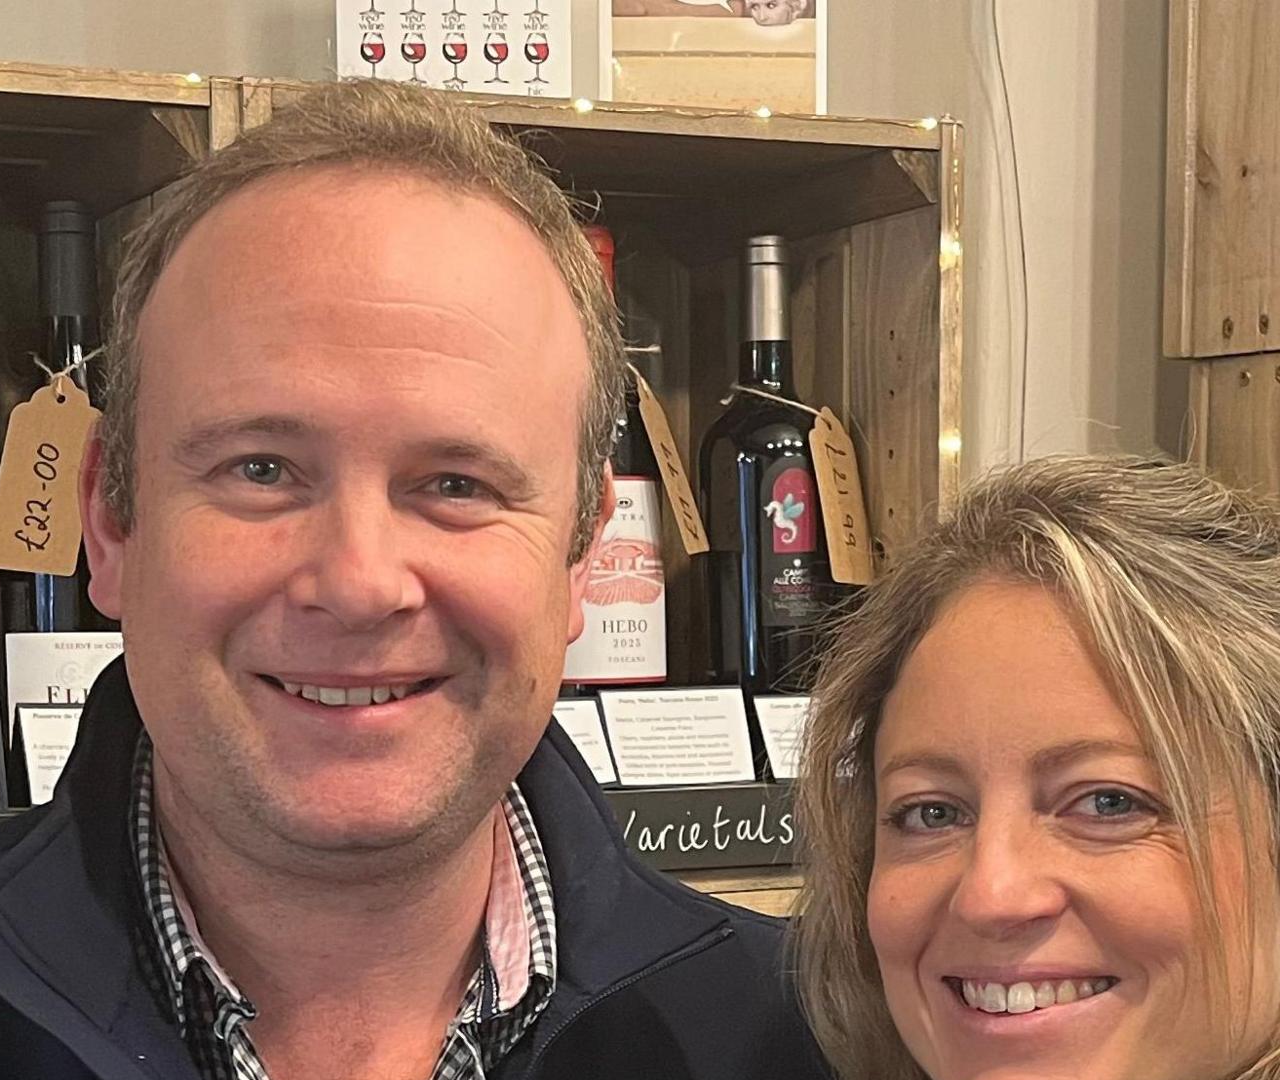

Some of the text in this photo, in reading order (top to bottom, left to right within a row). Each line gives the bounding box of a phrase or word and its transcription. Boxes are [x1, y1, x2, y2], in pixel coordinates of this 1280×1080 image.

[359, 22, 384, 31] wine
[400, 22, 425, 31] wine
[441, 22, 465, 31] wine
[482, 22, 507, 31] wine
[523, 22, 549, 31] wine
[602, 619, 648, 635] HEBO
